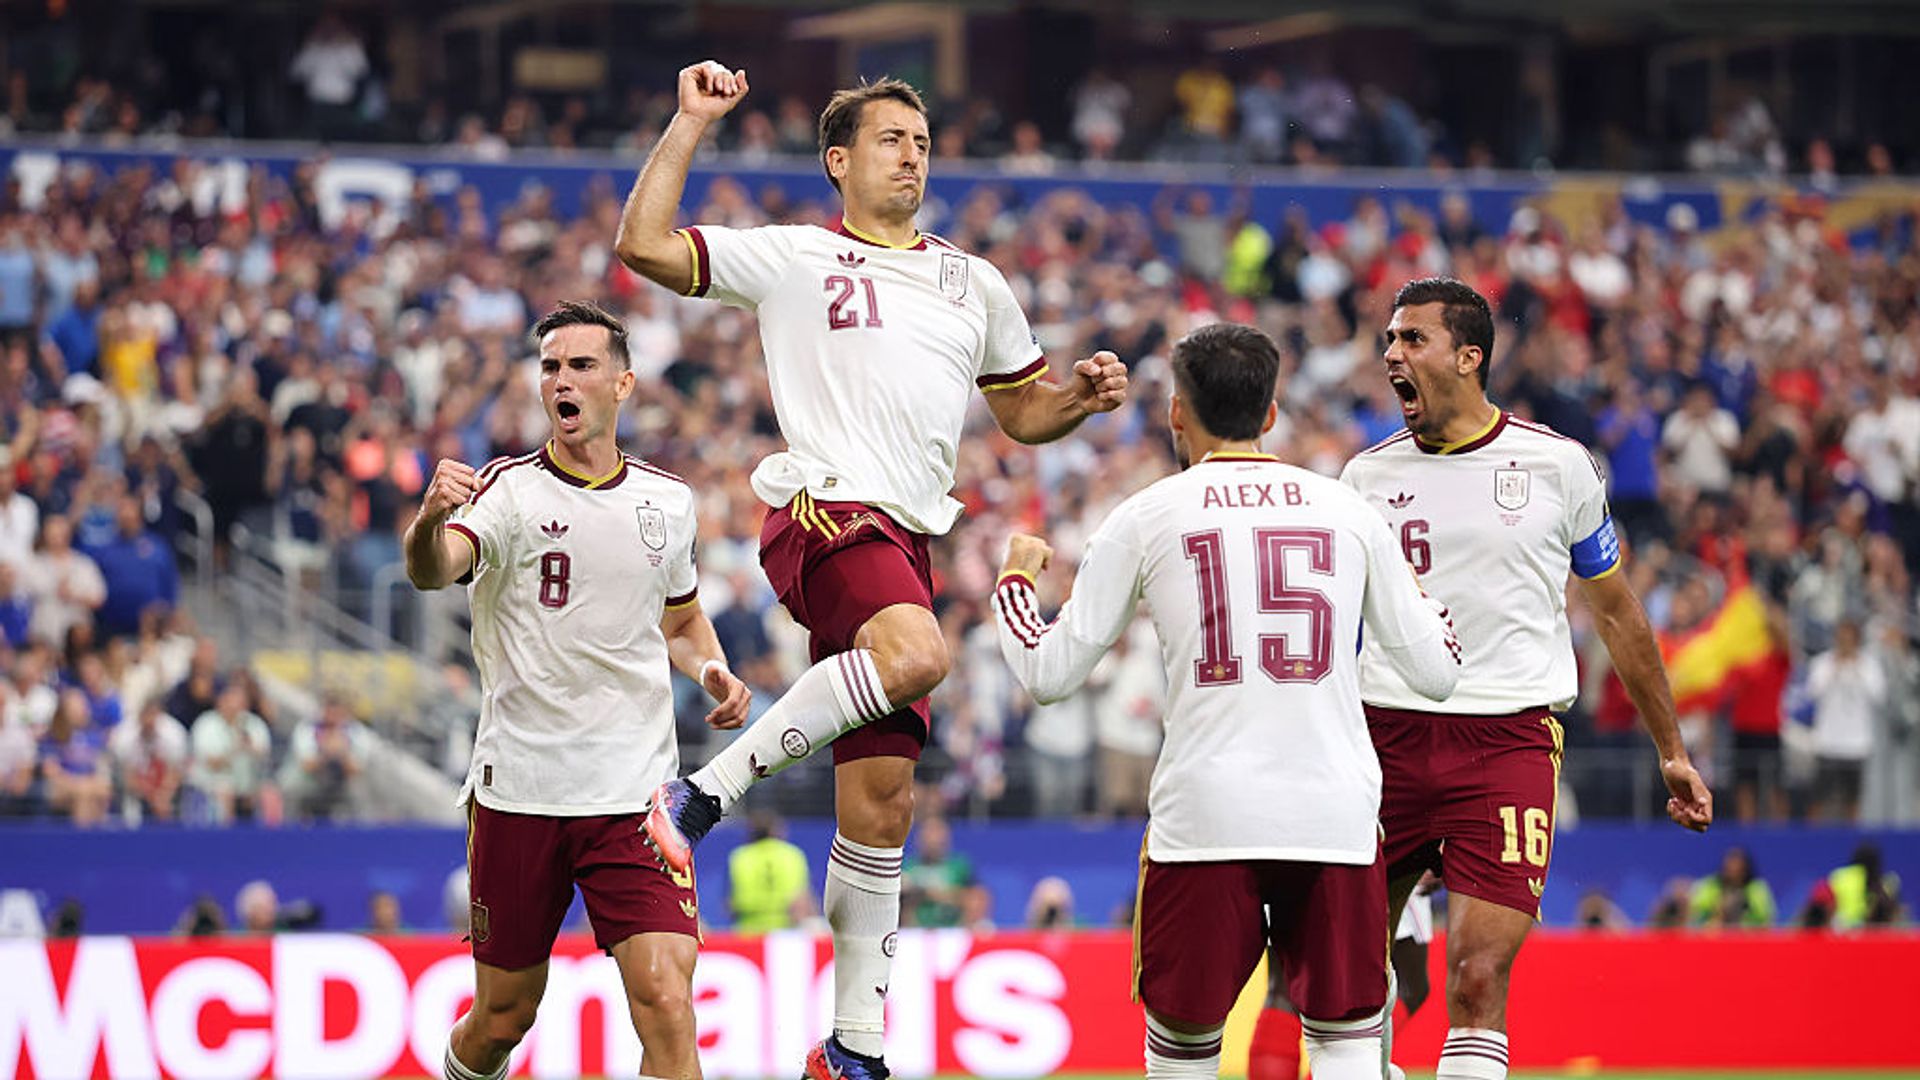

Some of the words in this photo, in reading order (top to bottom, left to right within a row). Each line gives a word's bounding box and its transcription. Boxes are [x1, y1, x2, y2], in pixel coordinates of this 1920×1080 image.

[824, 275, 883, 331] 21
[1203, 483, 1276, 508] ALEX
[1284, 482, 1311, 507] B.
[1388, 519, 1431, 575] 6
[539, 551, 571, 609] 8
[1182, 527, 1335, 687] 15
[1498, 806, 1549, 868] 16
